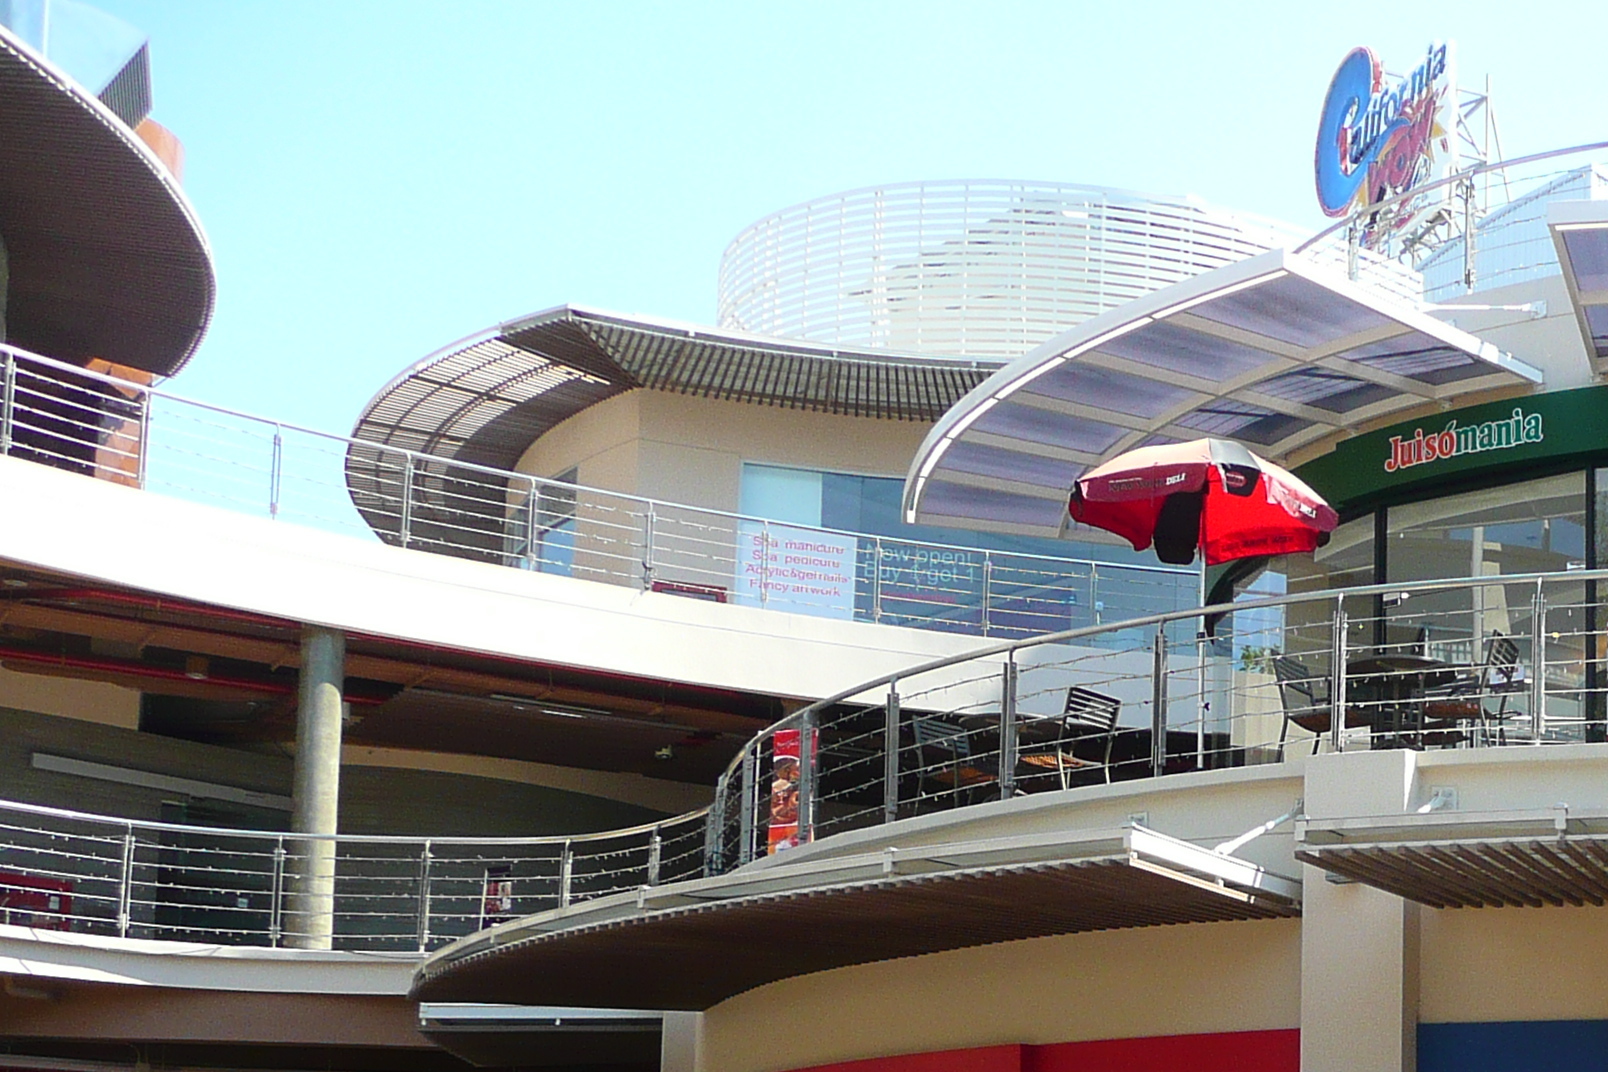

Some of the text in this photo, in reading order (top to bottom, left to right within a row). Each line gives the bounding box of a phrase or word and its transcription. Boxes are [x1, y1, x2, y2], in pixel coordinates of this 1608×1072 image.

[1313, 46, 1447, 218] California
[753, 536, 845, 554] Sa manicure
[752, 549, 840, 568] Sa pedicure
